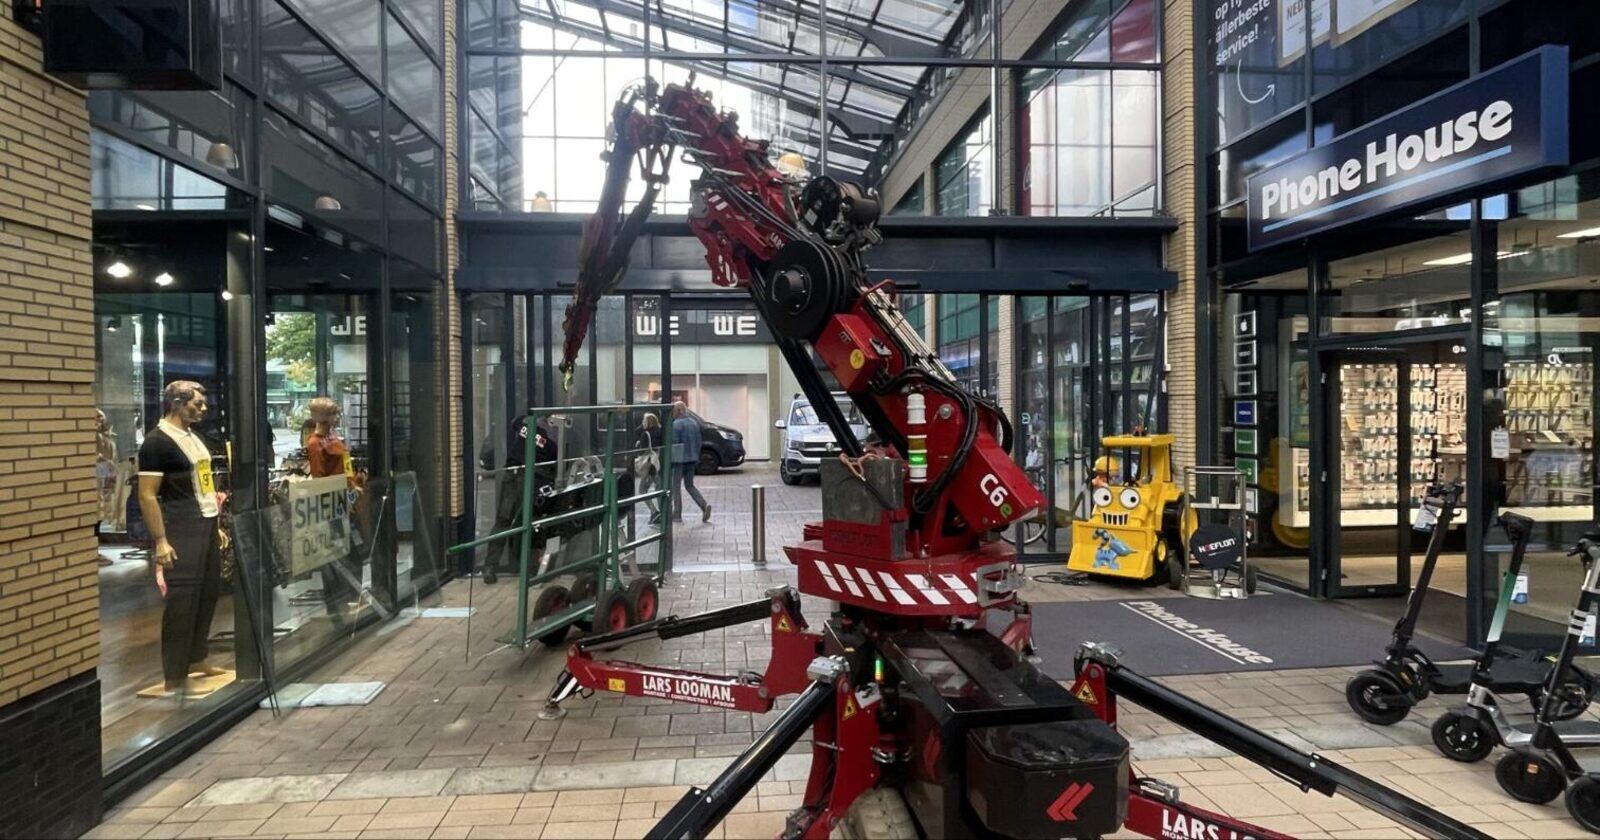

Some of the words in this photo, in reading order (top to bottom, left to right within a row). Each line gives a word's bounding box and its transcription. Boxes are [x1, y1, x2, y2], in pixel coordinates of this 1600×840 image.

[1215, 2, 1228, 20] op
[1215, 24, 1259, 66] service!
[713, 315, 757, 336] WE
[294, 488, 348, 529] SHEIN
[642, 675, 671, 693] LARS
[676, 680, 735, 703] LOOMAN.
[1162, 809, 1219, 840] LARS
